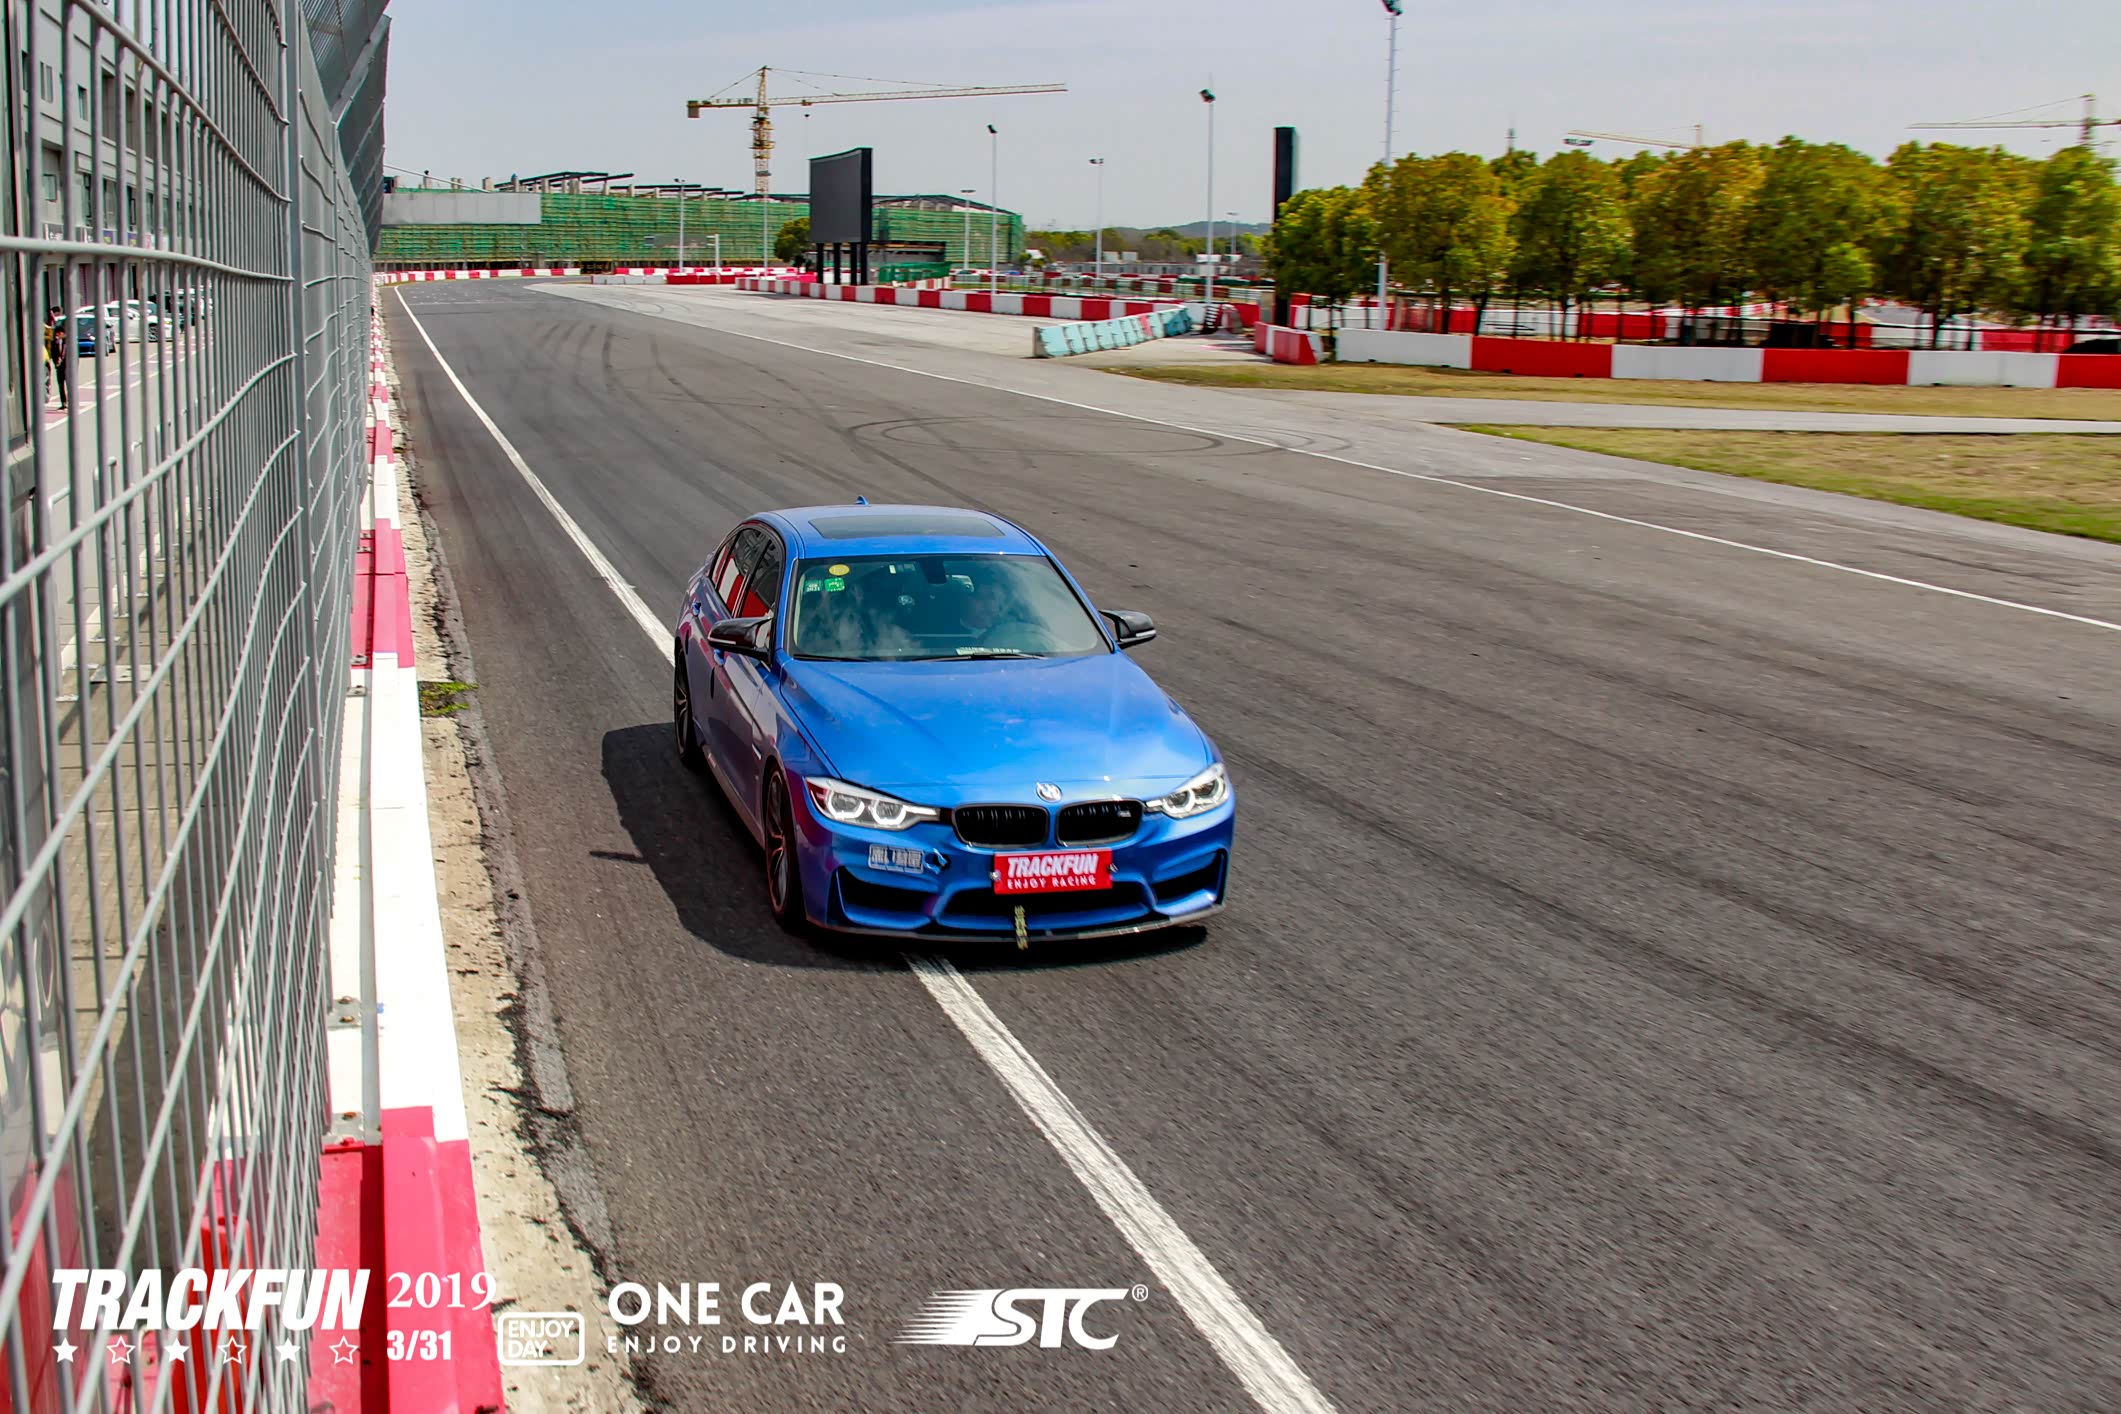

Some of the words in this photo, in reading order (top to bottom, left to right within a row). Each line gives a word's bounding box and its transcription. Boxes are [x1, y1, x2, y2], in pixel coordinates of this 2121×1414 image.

[1007, 853, 1099, 877] TRACKFUN
[1007, 877, 1046, 889] ENJOY
[1052, 875, 1096, 887] RACING
